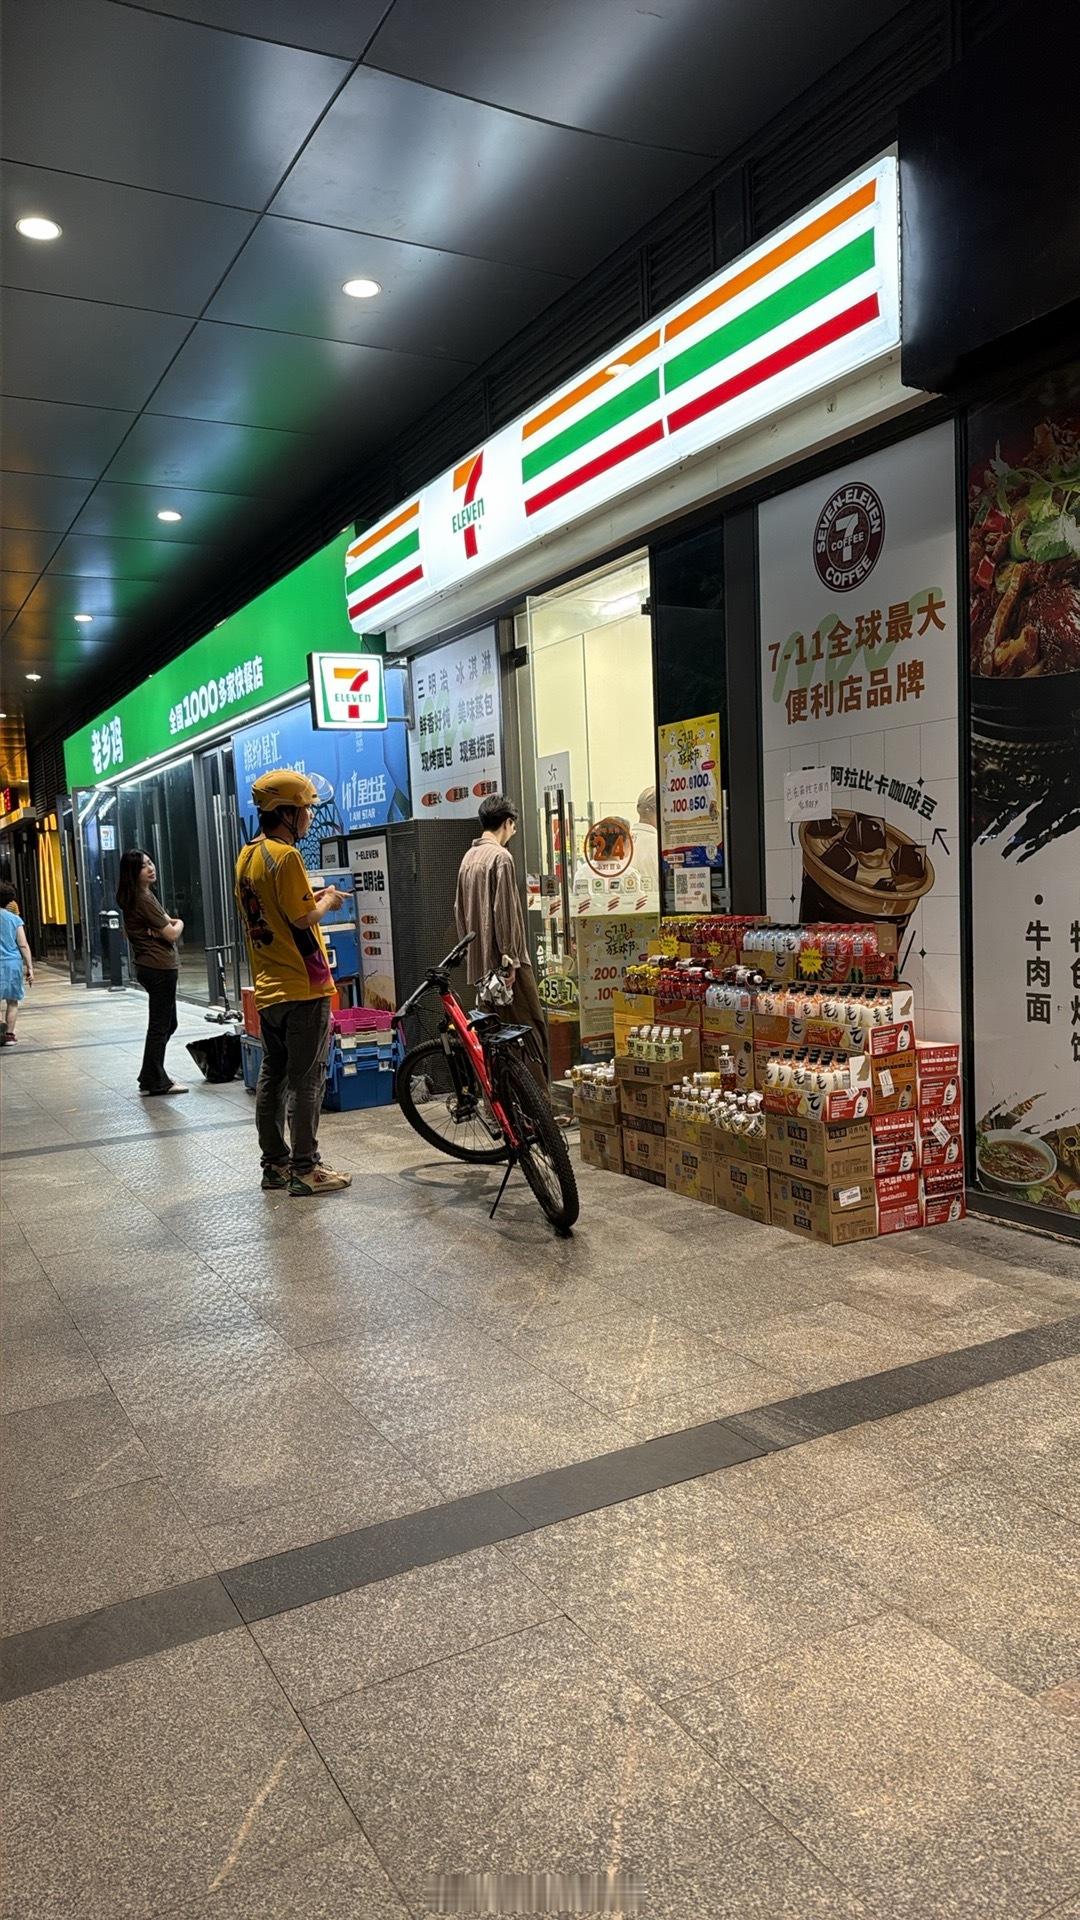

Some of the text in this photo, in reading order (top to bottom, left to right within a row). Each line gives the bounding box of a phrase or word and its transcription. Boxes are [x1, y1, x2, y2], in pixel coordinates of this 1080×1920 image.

[453, 450, 484, 560] 7
[816, 488, 881, 554] SEVEN-ELEVEN
[831, 531, 865, 552] COFFEE
[835, 512, 859, 562] 7
[825, 554, 872, 587] COFFEE
[768, 592, 947, 673] 7-11全球最大
[168, 655, 264, 736] 全国1000多家快餐店
[784, 659, 926, 725] 便利店品牌
[90, 715, 124, 775] 老乡鸡
[421, 746, 453, 772] 现烤面包
[802, 766, 938, 821] 阿拉比卡咖啡豆
[355, 849, 380, 860] 7-ELEVEN
[593, 834, 625, 861] 24
[354, 871, 385, 892] 三明治
[1025, 919, 1052, 1025] 牛肉面
